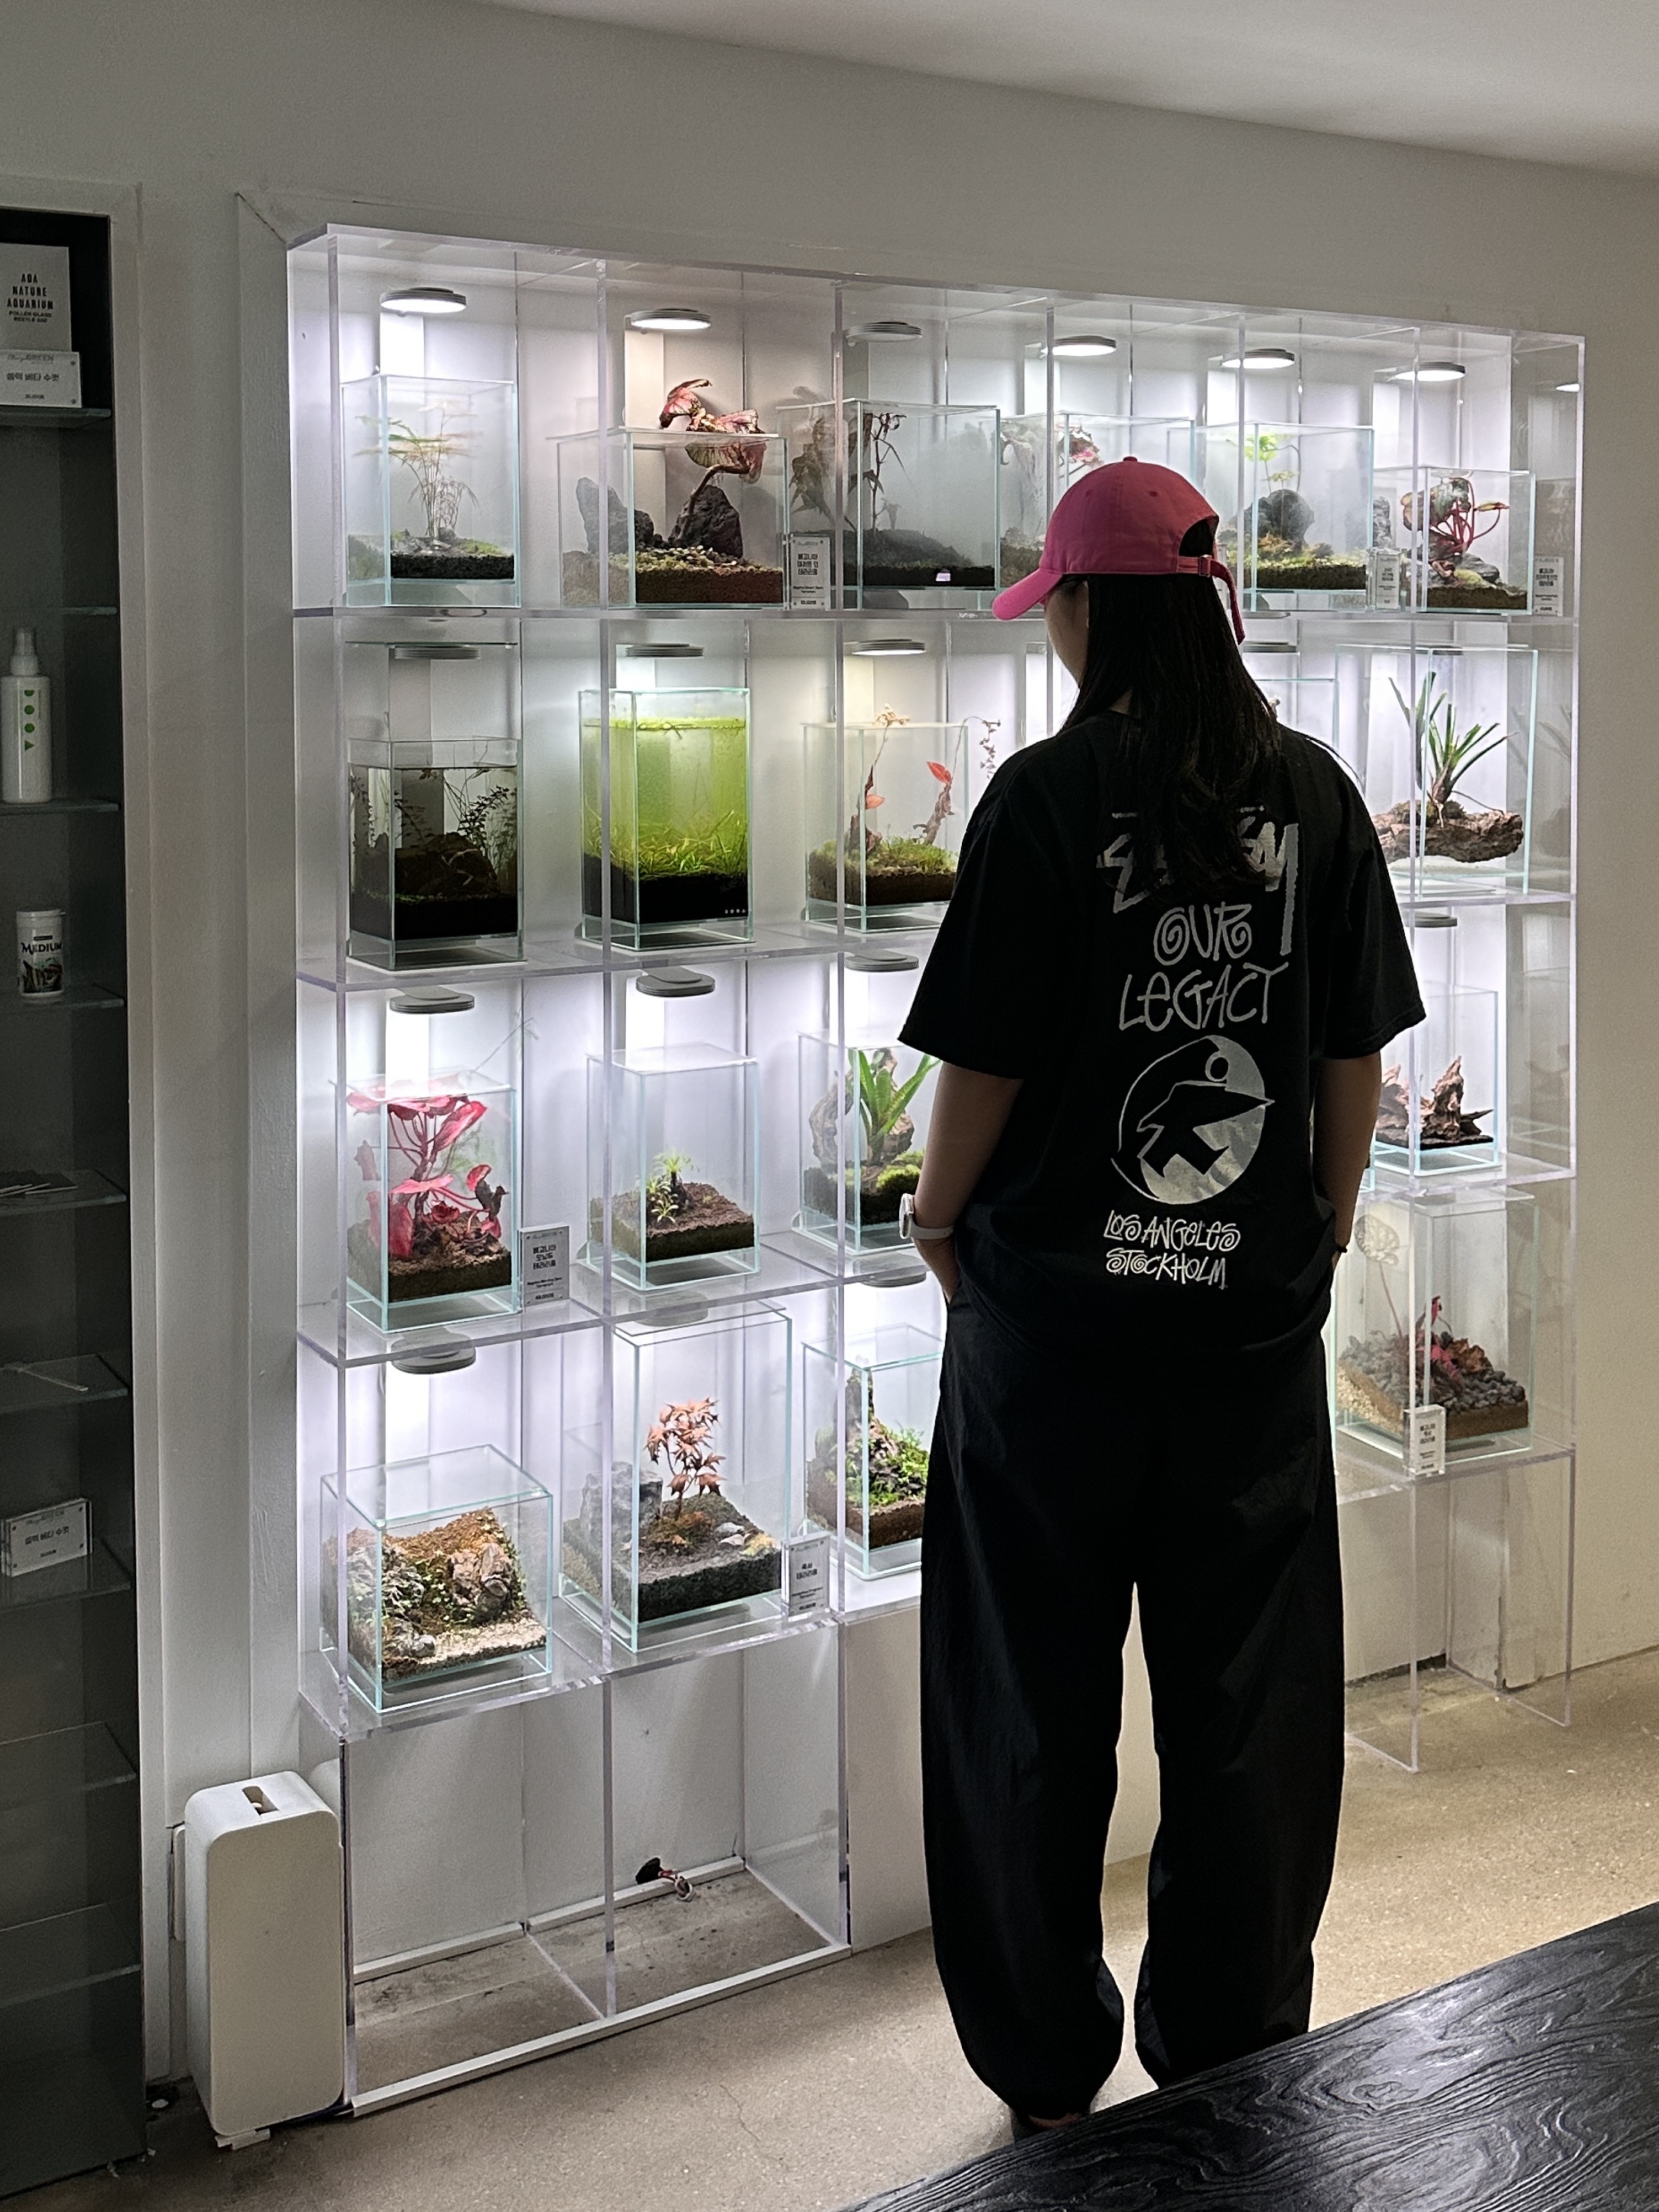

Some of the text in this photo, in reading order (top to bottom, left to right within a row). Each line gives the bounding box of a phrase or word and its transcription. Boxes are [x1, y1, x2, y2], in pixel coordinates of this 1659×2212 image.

[21, 273, 38, 283] ADA
[12, 285, 47, 297] NATURE
[7, 298, 54, 310] AQUARIUM
[1153, 901, 1252, 966] OUR
[1103, 1210, 1142, 1241] LOS
[1106, 1248, 1229, 1290] STOCKHOLM
